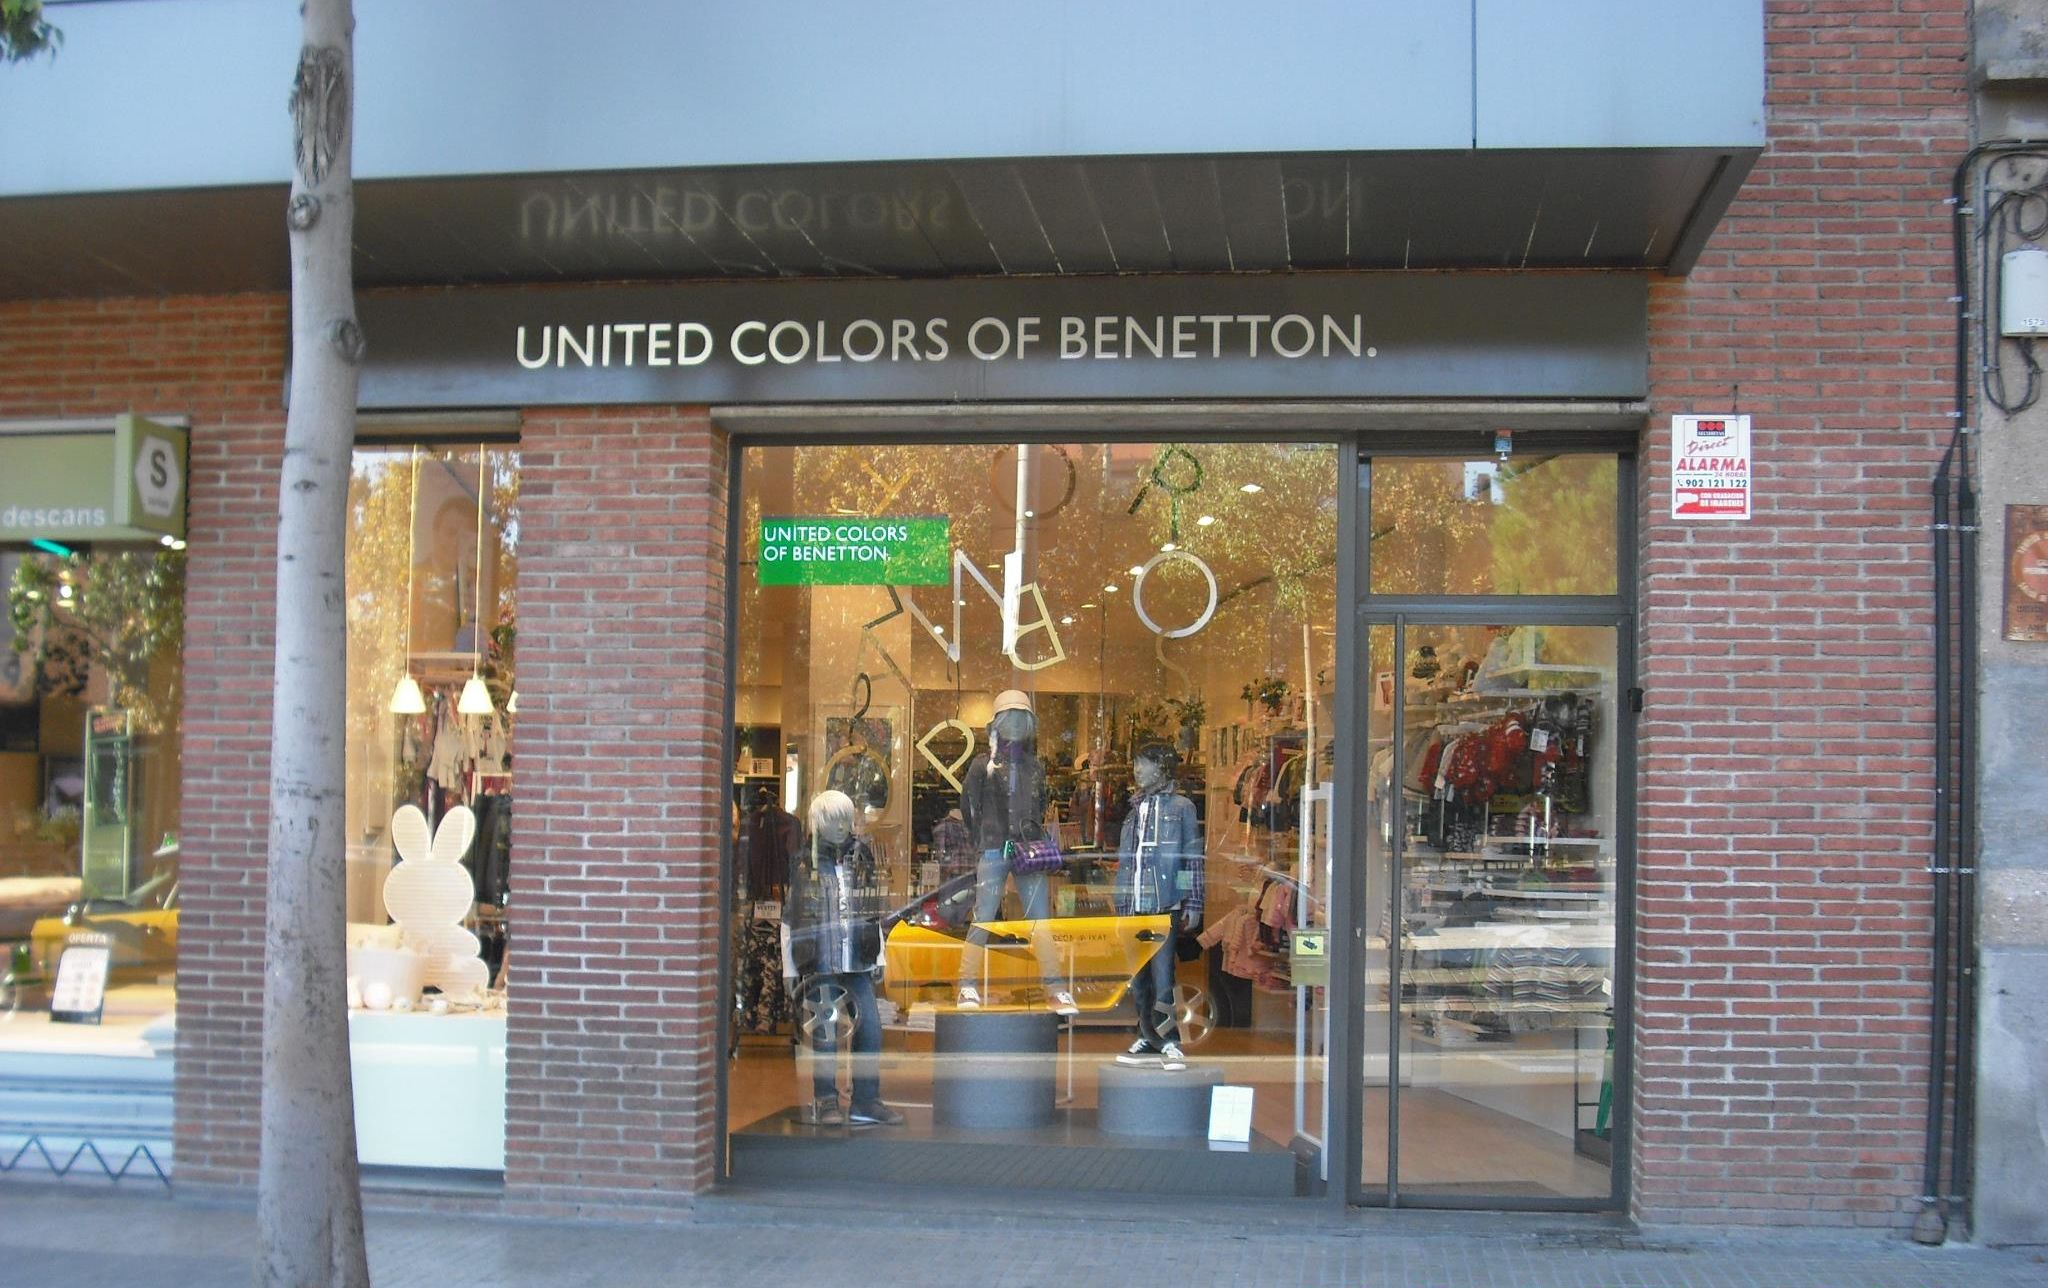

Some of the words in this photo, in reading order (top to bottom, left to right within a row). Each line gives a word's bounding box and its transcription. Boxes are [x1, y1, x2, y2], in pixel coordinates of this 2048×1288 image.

[516, 321, 713, 369] UNITED
[729, 318, 950, 365] COLORS
[967, 316, 1041, 361] OF
[1059, 314, 1378, 359] BENETTON.
[1687, 436, 1735, 455] Direct
[149, 450, 168, 489] S
[1676, 458, 1747, 471] ALARMA
[1685, 480, 1704, 488] 902
[1708, 480, 1725, 488] 121
[1730, 480, 1748, 488] 122
[2, 504, 105, 528] descans
[764, 525, 831, 542] UNITED
[836, 526, 908, 542] COLORS
[763, 546, 788, 561] OF
[68, 933, 107, 945] OFERTA
